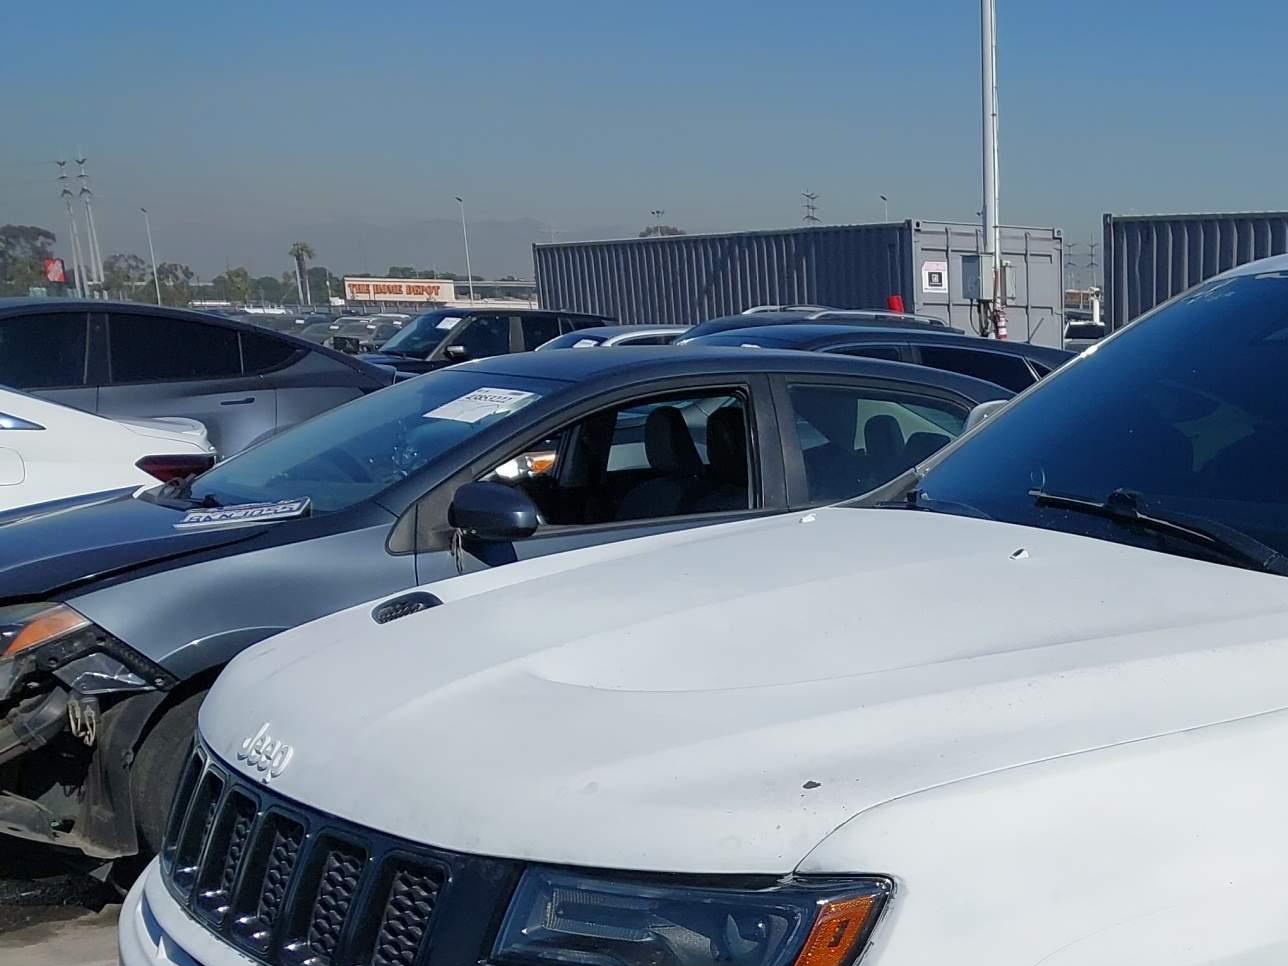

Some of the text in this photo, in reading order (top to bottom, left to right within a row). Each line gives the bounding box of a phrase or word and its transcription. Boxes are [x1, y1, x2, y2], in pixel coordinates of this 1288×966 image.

[348, 283, 440, 296] THE HOME DEPOT
[237, 722, 294, 784] Jeep
